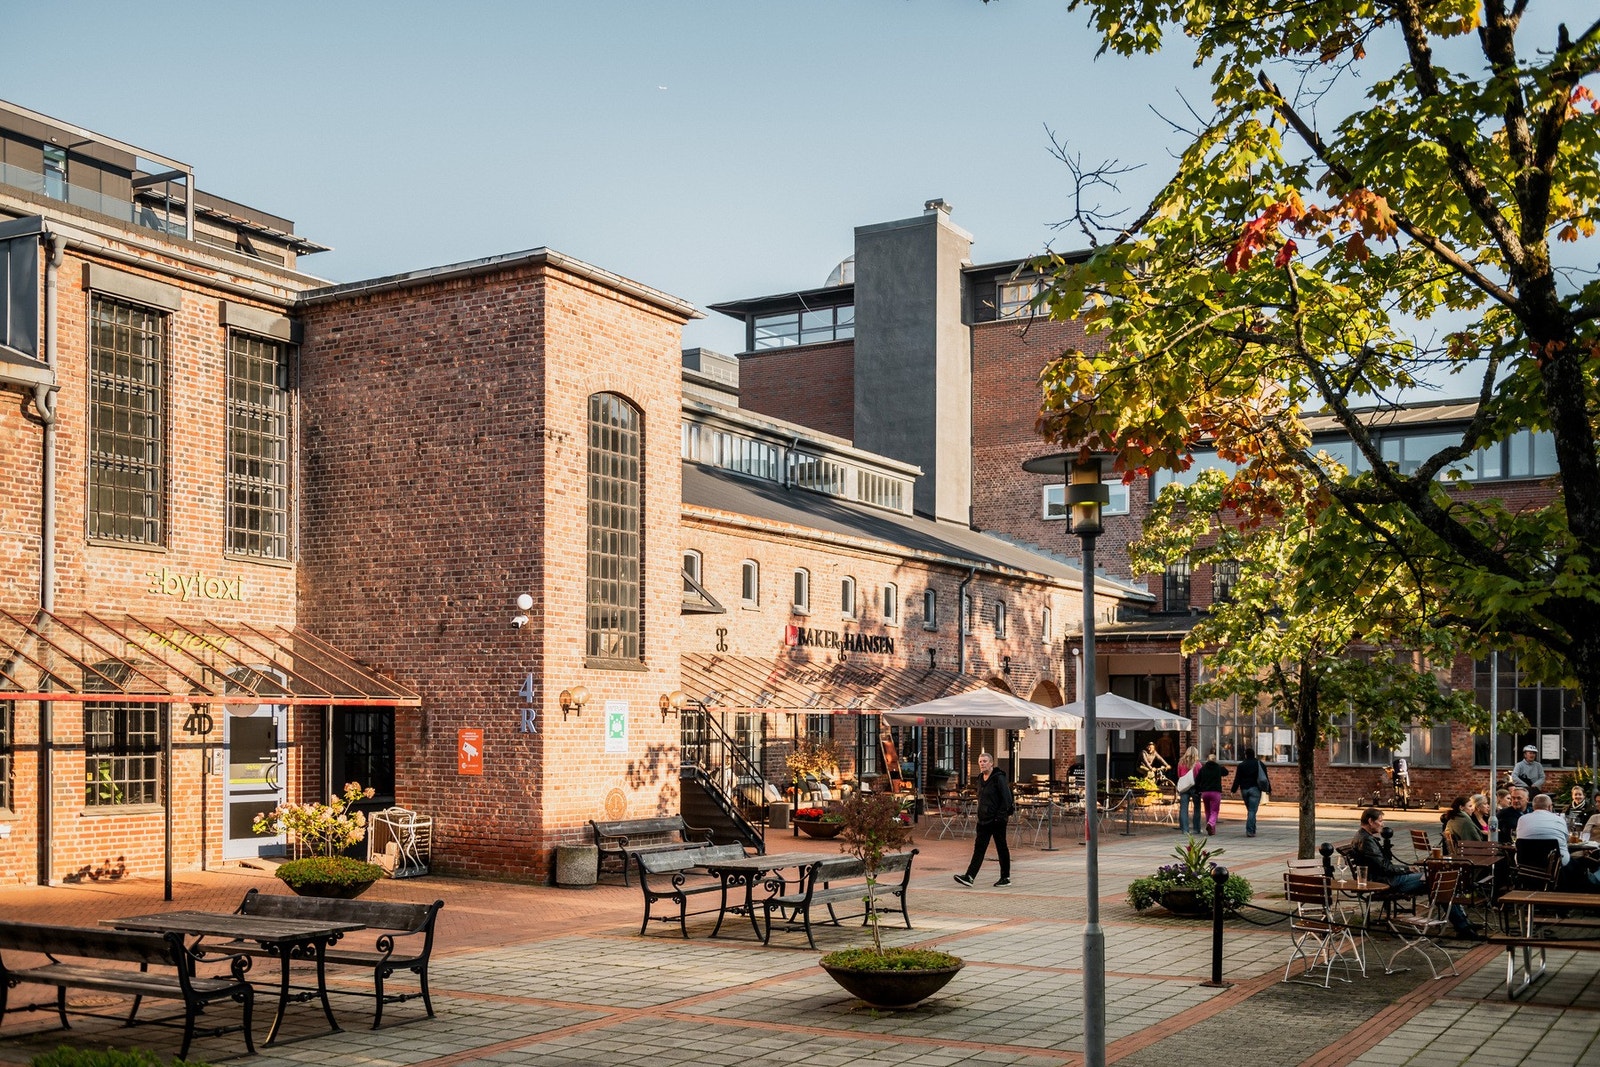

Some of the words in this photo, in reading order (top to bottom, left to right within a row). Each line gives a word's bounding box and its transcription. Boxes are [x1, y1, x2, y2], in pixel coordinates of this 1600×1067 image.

[161, 567, 244, 602] bytaxi
[798, 626, 841, 650] BAKER
[844, 632, 895, 655] HANSEN
[519, 672, 535, 703] 4
[183, 713, 214, 735] 4D
[520, 708, 537, 733] R
[925, 718, 952, 726] BAKER
[955, 718, 992, 727] HANSEN
